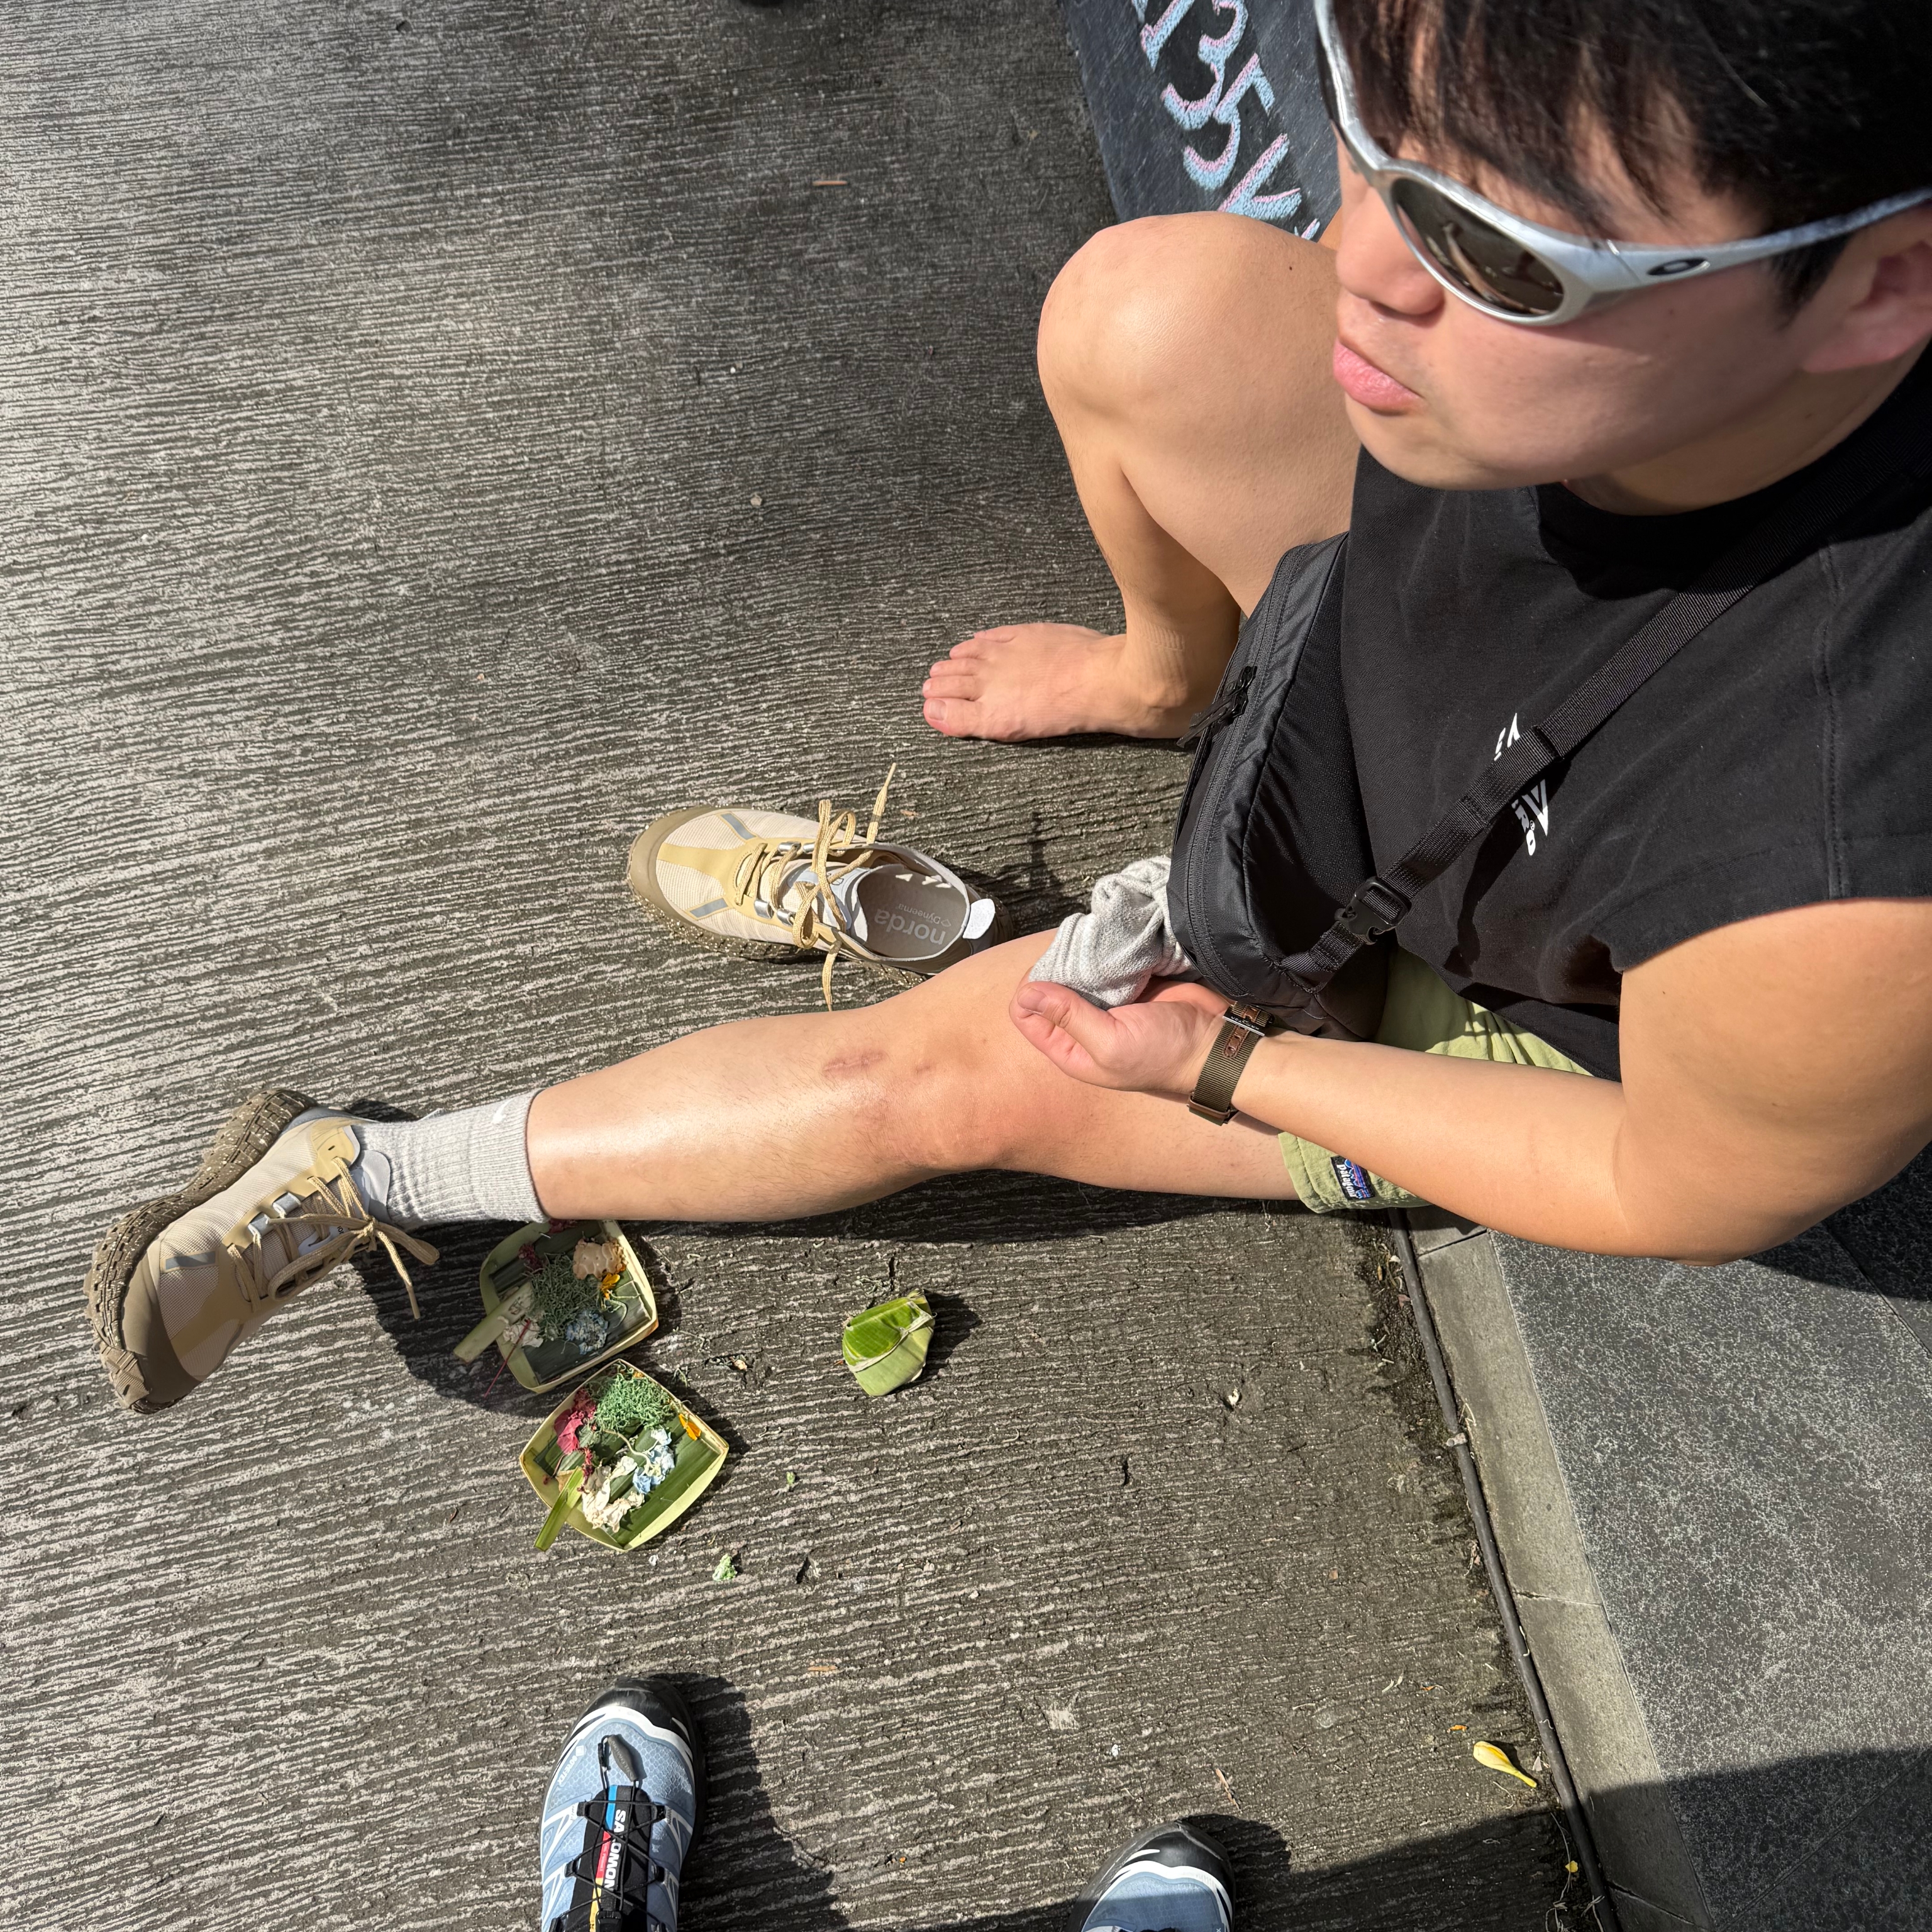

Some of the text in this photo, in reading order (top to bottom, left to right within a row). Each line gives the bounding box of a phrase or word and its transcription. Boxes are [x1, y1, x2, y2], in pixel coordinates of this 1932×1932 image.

[874, 908, 946, 945] norda
[898, 903, 941, 924] Dyneema
[1336, 1164, 1357, 1197] patagonia
[603, 1809, 626, 1889] SAOMON
